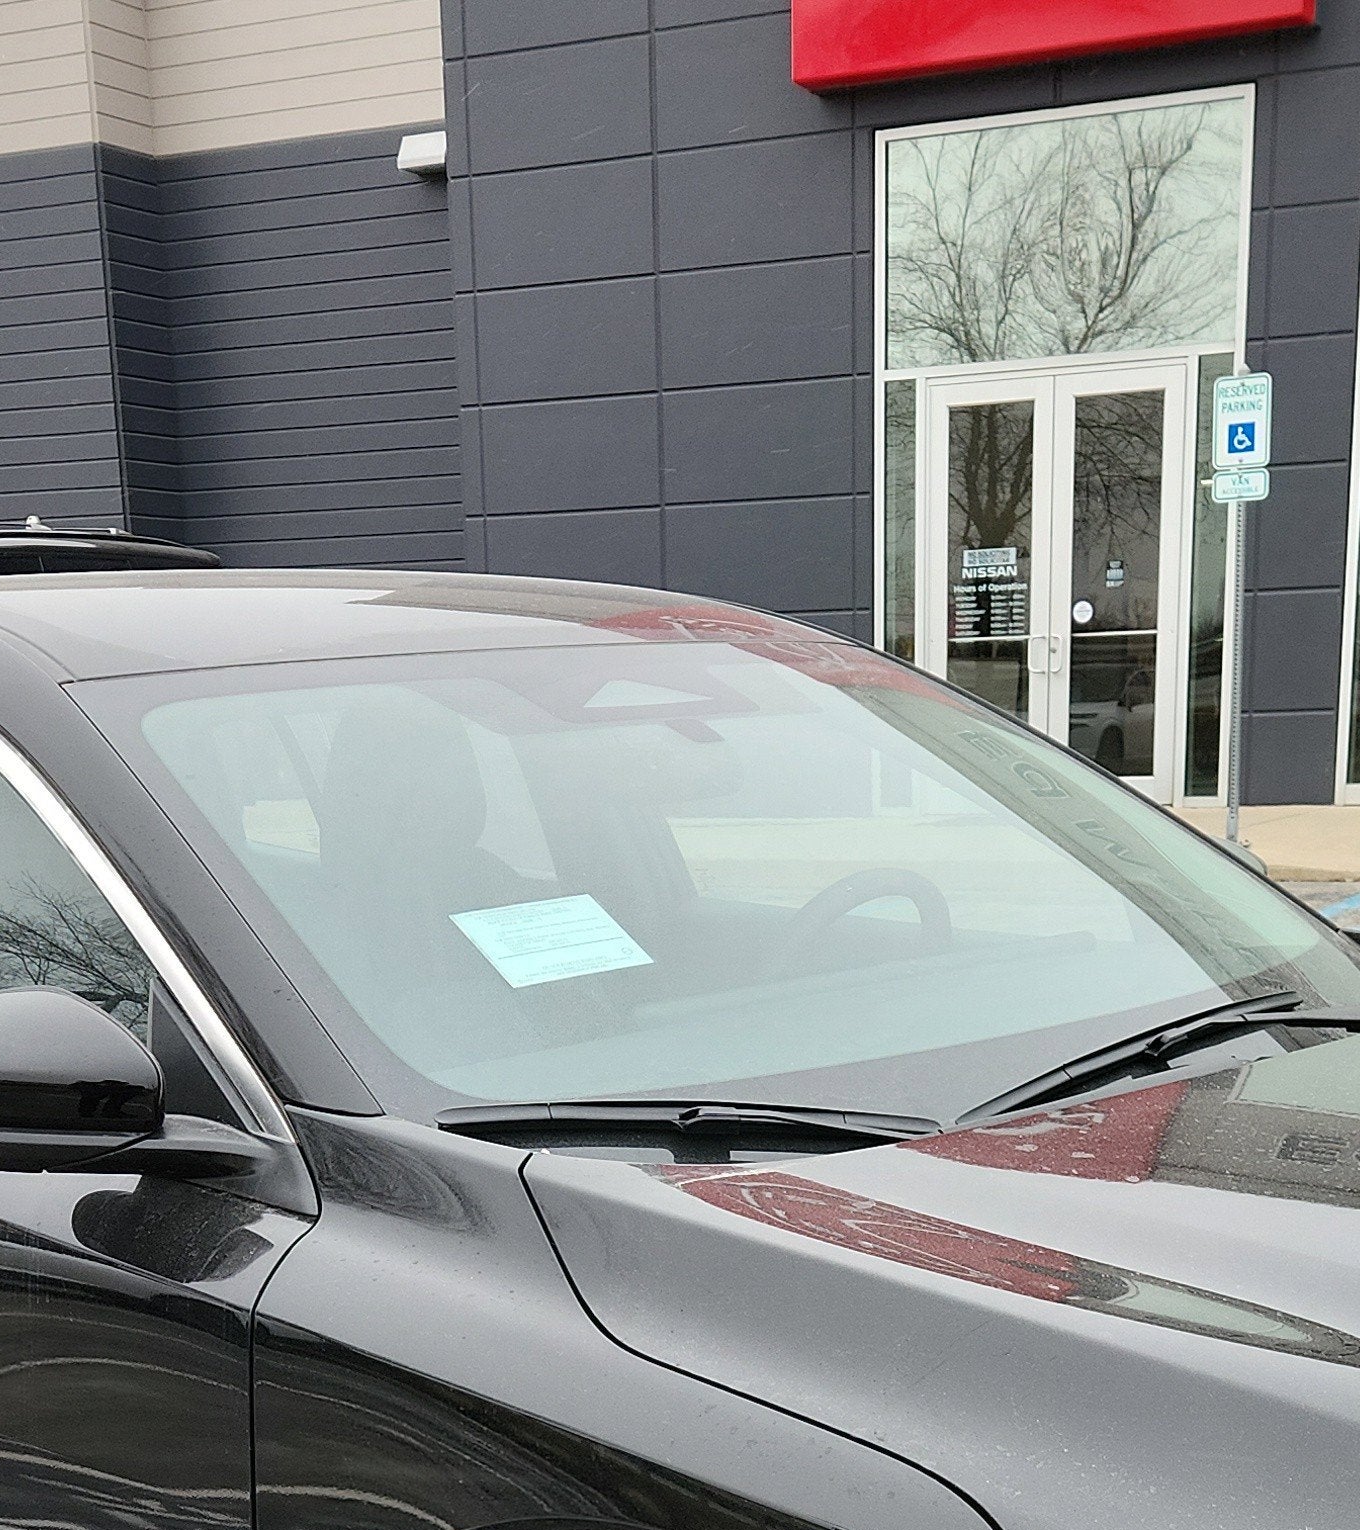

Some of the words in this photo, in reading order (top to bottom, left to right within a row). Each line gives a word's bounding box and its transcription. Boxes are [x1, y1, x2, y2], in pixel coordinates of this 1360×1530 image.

[1218, 383, 1266, 398] RESERVED
[1221, 399, 1263, 413] PARKING
[961, 565, 1018, 579] NISSAN
[953, 584, 976, 594] Hours
[978, 583, 987, 592] of
[988, 582, 1028, 593] Operation
